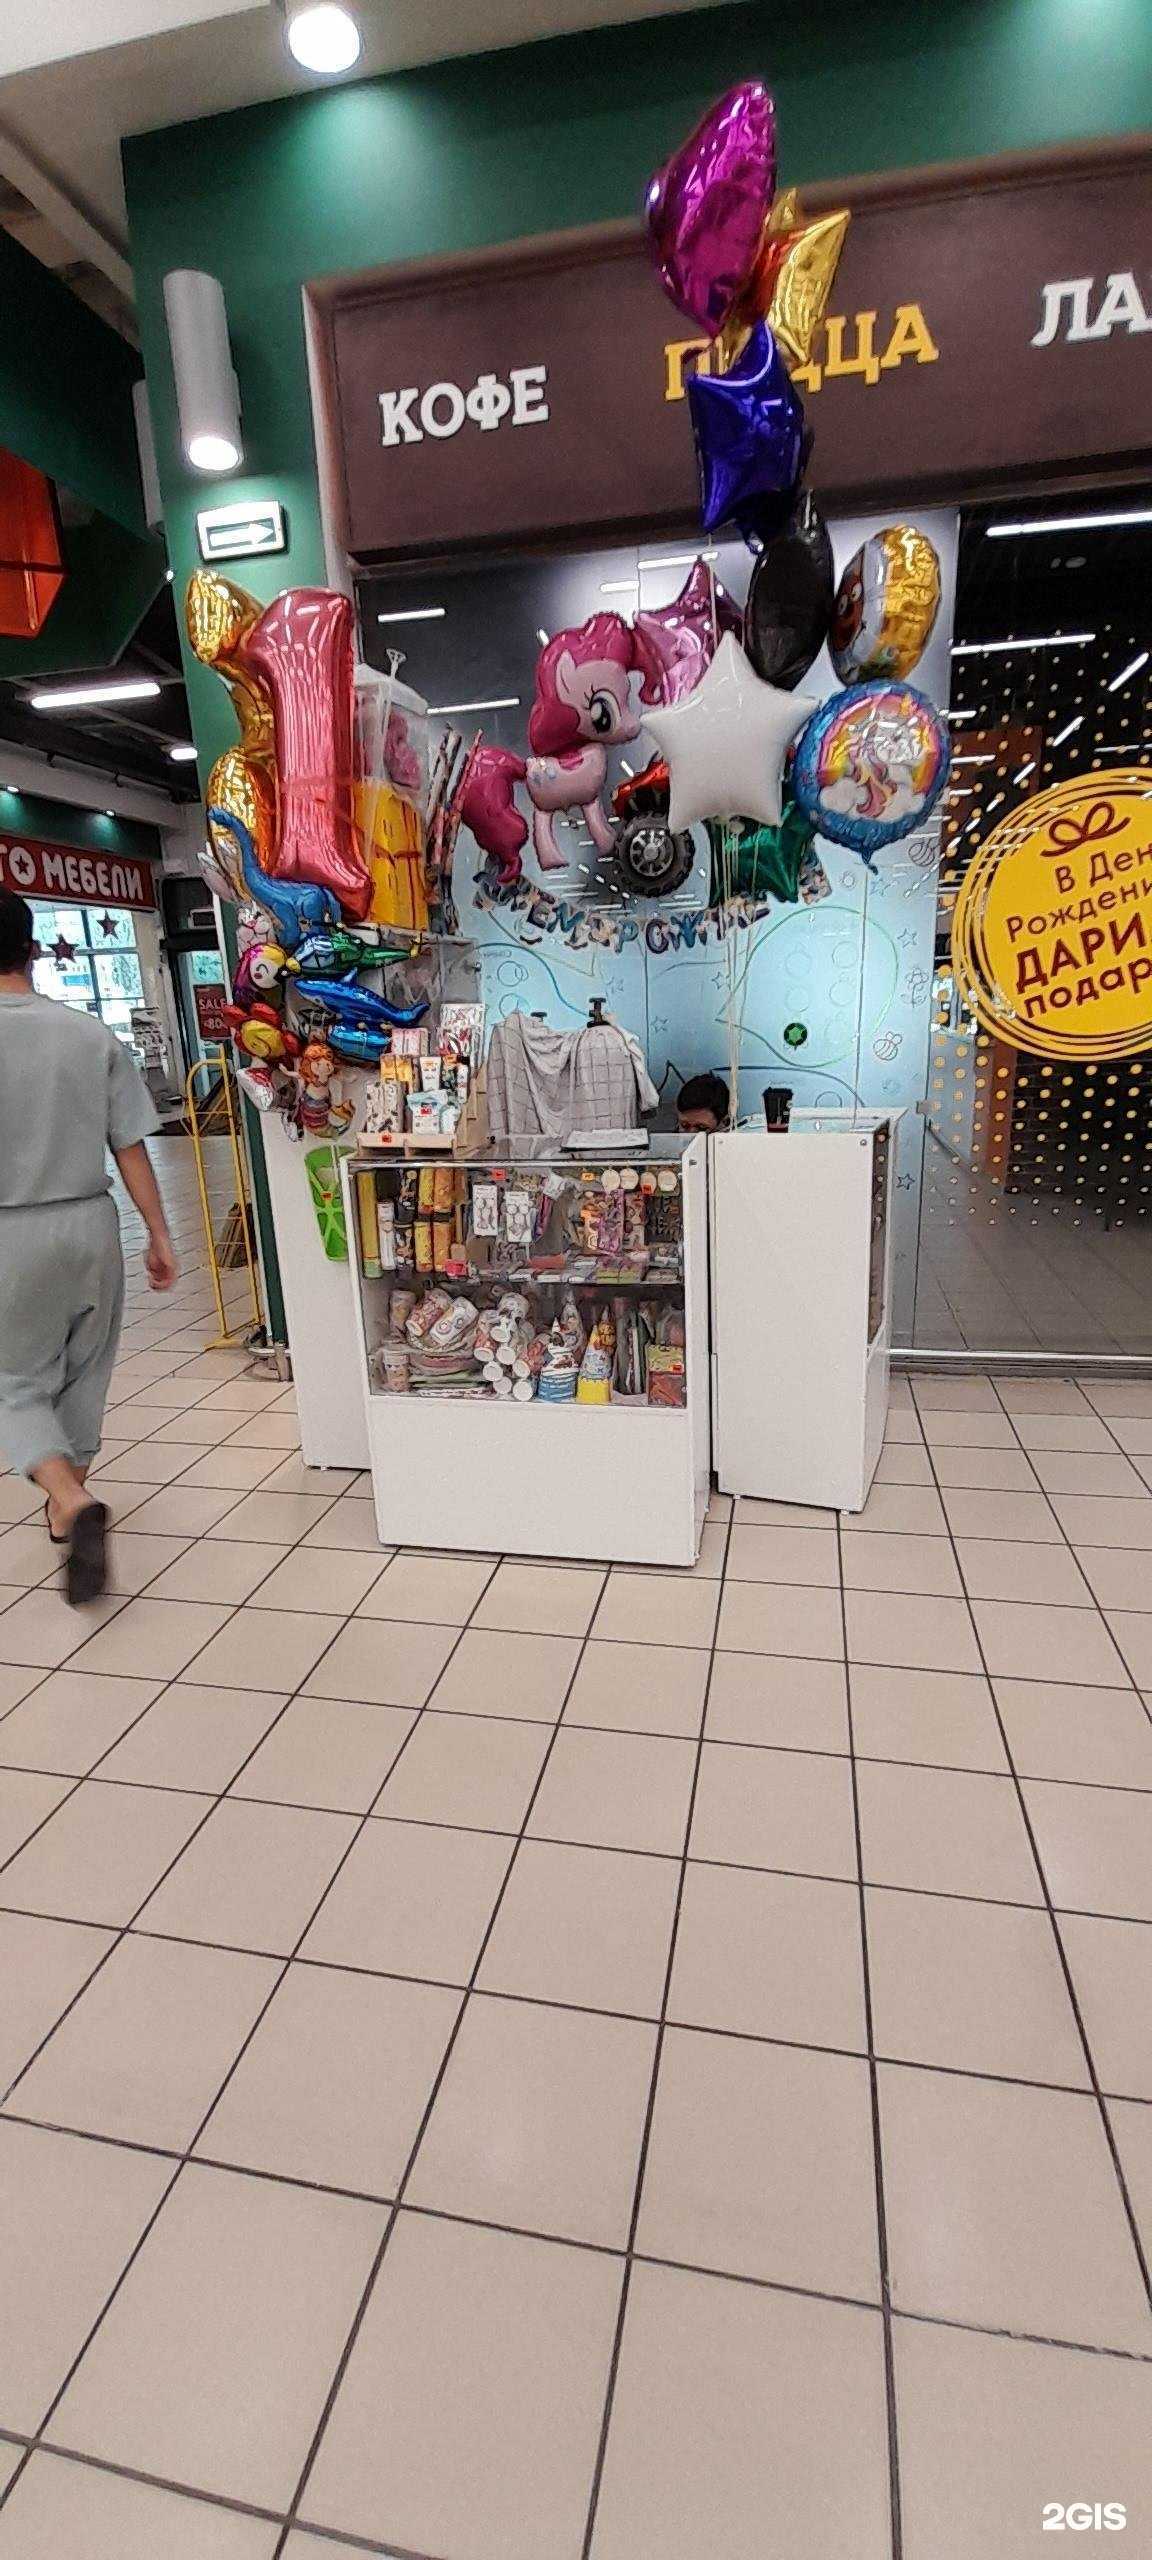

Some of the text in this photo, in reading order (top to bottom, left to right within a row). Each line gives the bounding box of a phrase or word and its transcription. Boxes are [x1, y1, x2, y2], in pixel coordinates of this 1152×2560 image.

[378, 366, 550, 446] КОФЕ
[664, 303, 940, 401] ПЦА
[42, 849, 143, 900] МЕБЕЛИ
[1055, 865, 1076, 894] В
